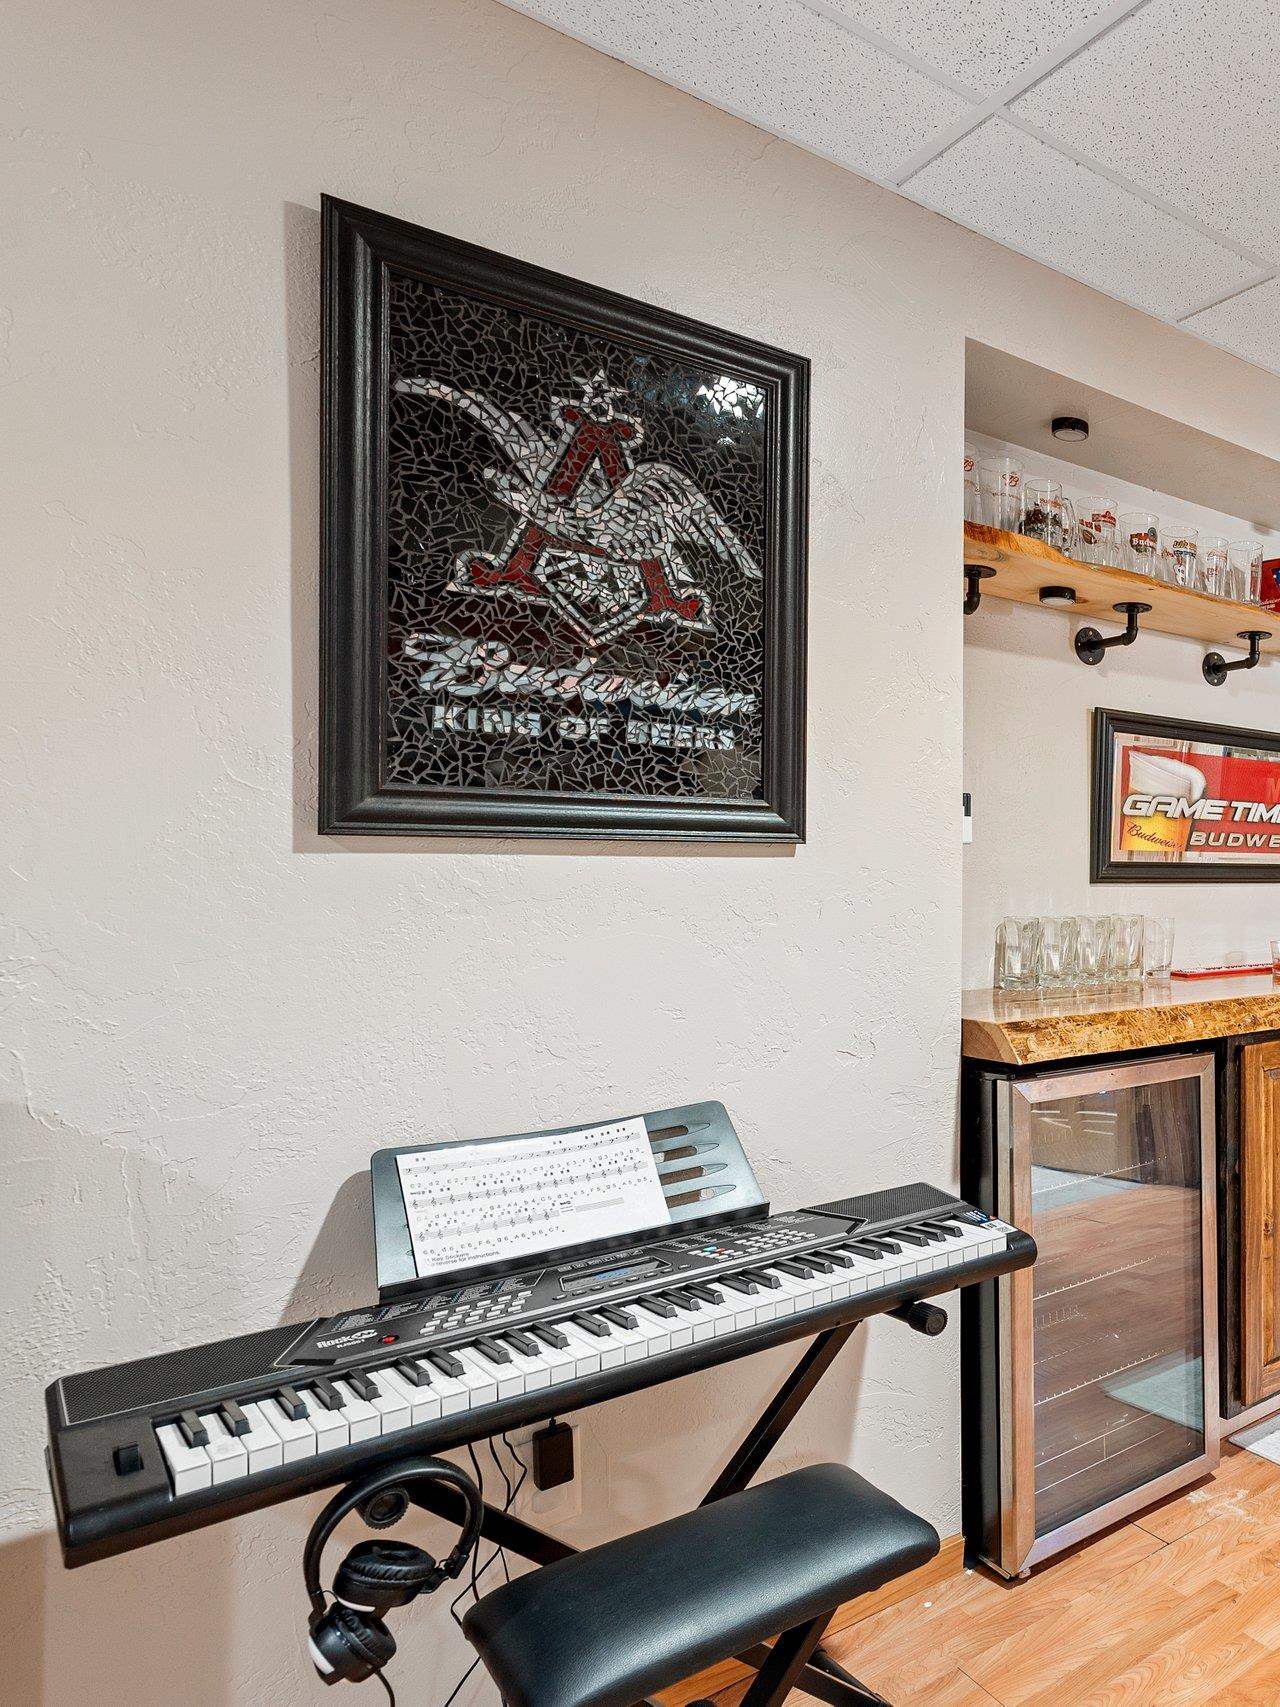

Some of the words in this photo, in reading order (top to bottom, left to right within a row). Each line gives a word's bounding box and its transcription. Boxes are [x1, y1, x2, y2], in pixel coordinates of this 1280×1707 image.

[433, 705, 541, 736] KING
[557, 716, 608, 742] OF
[1122, 794, 1229, 820] GAME
